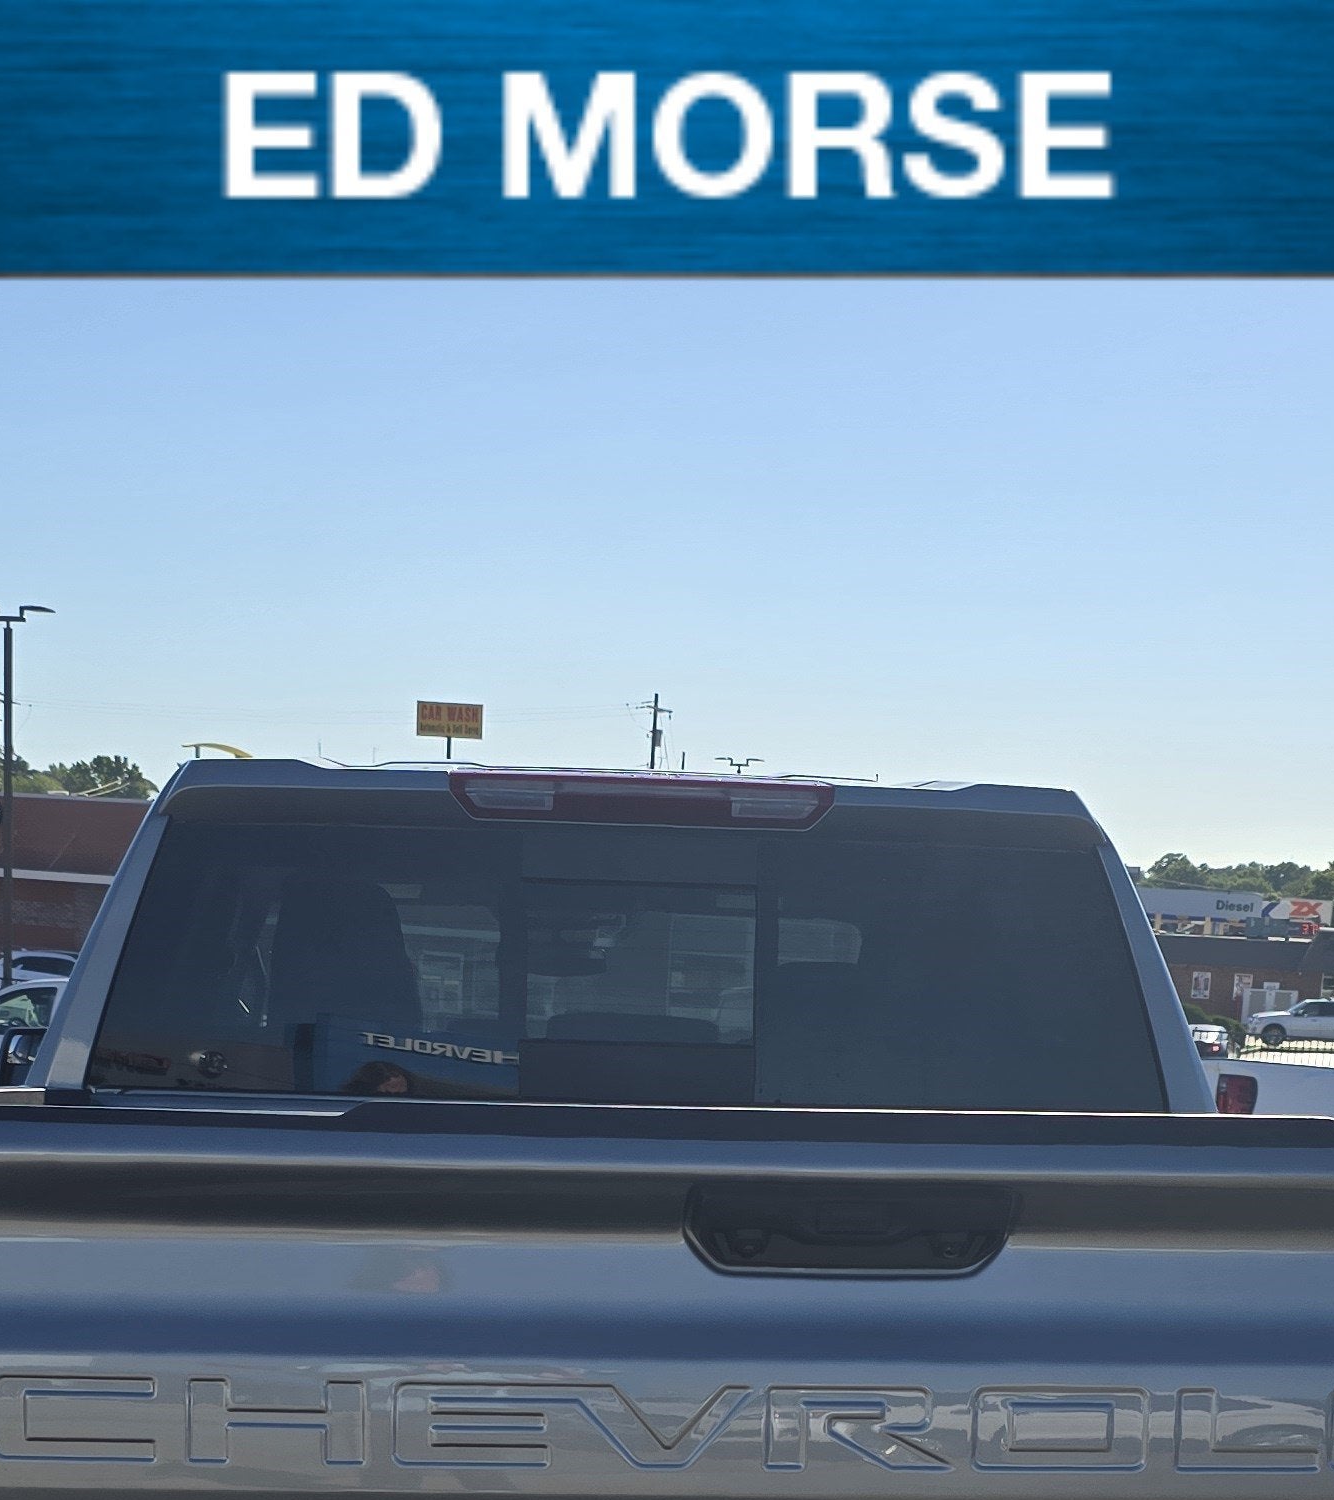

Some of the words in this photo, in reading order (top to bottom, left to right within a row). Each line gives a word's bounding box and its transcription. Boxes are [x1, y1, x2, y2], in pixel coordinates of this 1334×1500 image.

[420, 704, 442, 721] CAR
[447, 706, 479, 722] WASH
[1215, 899, 1254, 913] Diesel
